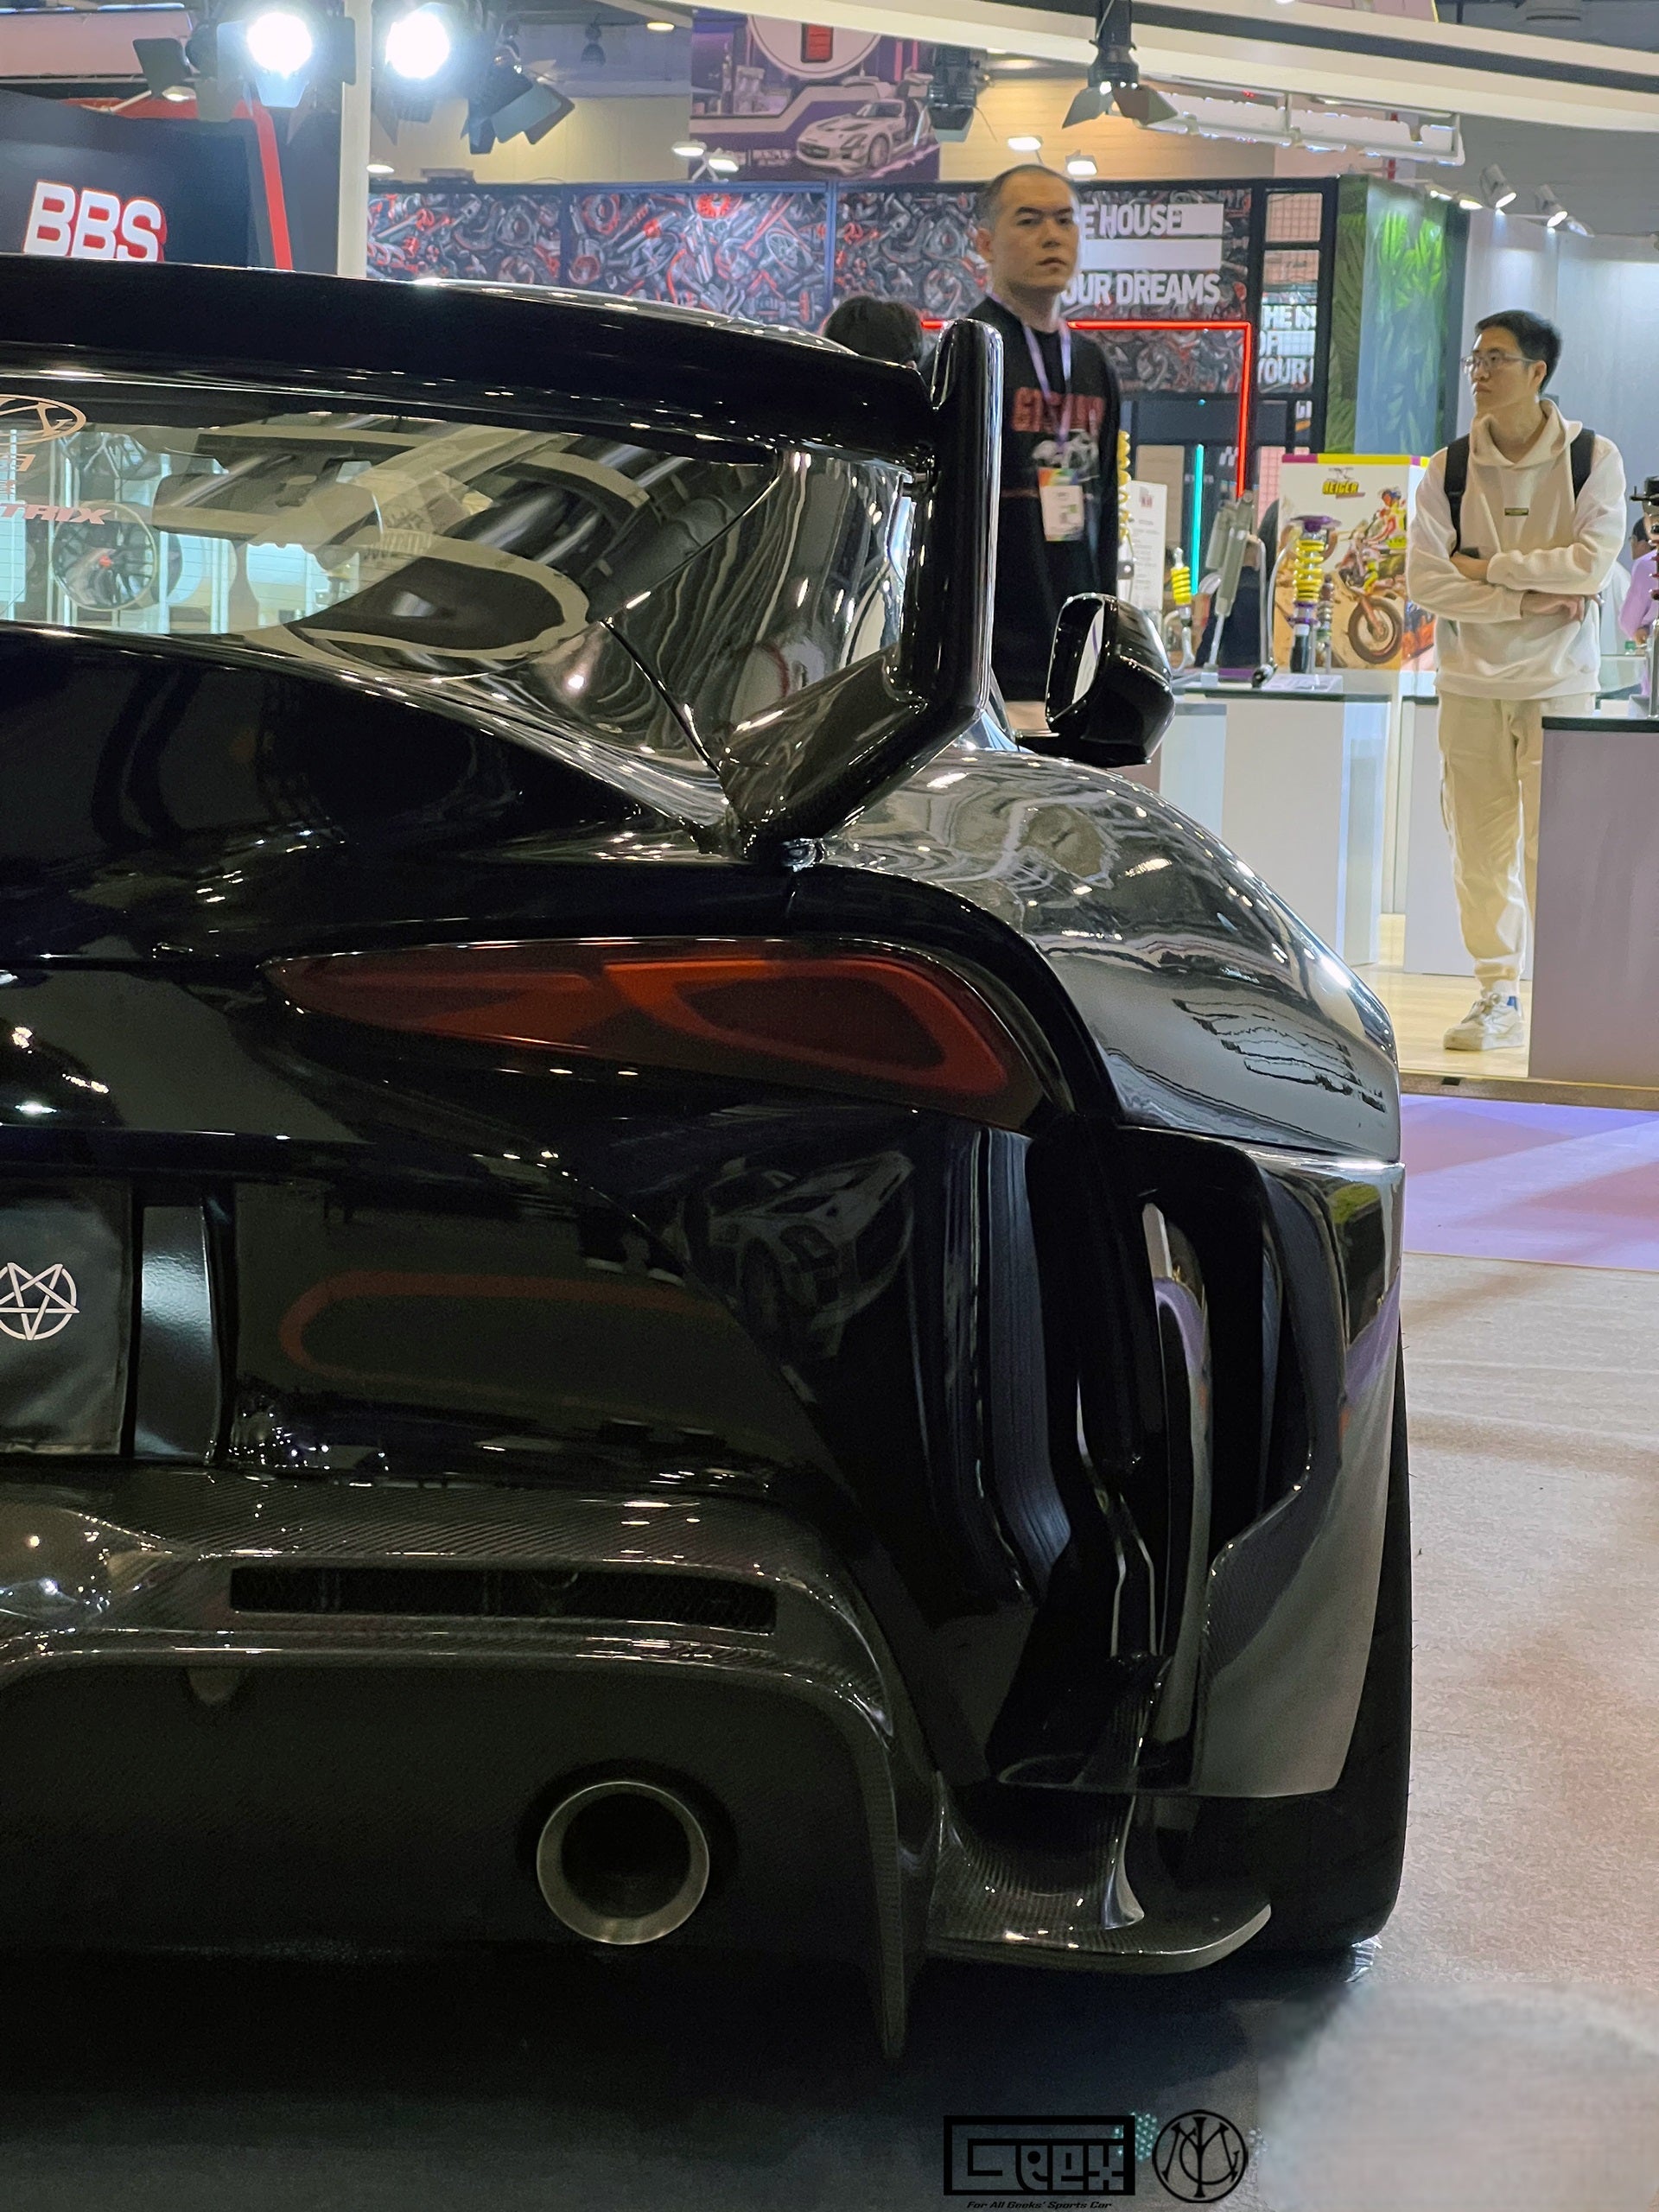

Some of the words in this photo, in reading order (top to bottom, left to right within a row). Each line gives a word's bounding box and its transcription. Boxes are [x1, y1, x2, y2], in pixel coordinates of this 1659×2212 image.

[22, 180, 166, 263] BBS
[1099, 203, 1182, 238] HOUSE
[1116, 272, 1221, 306] DREAMS
